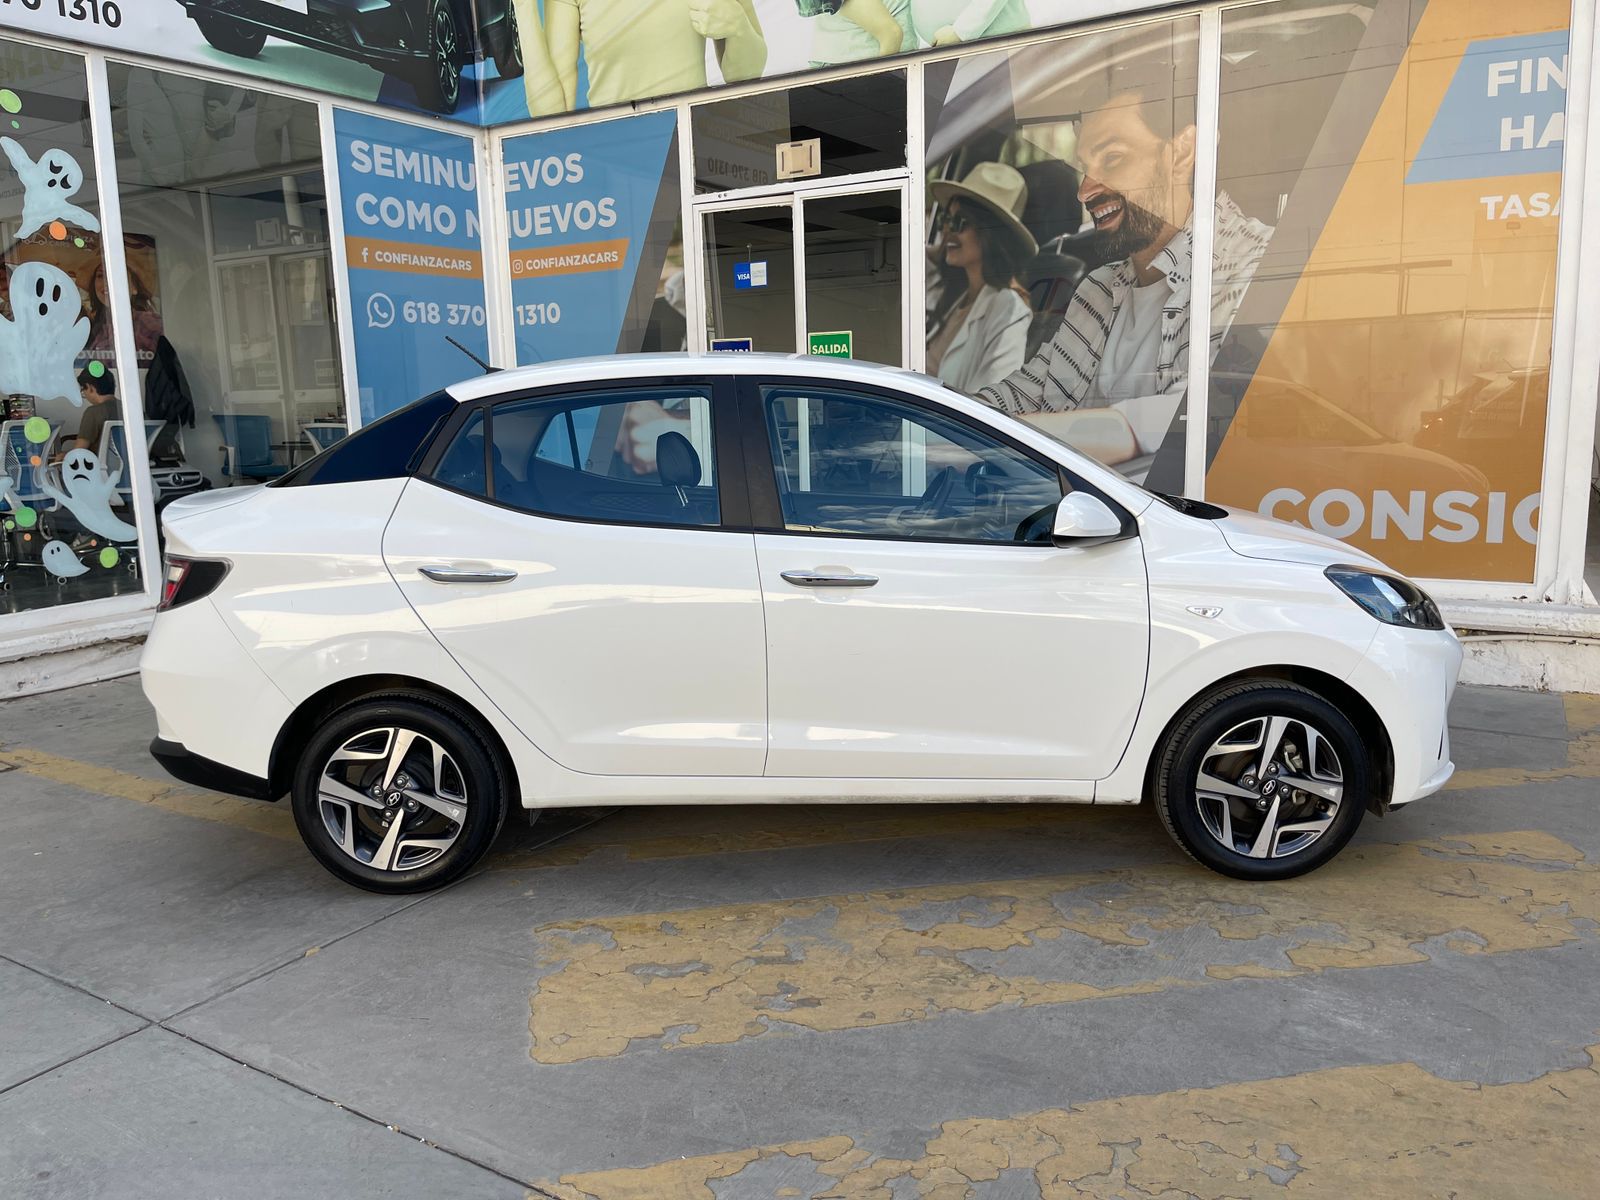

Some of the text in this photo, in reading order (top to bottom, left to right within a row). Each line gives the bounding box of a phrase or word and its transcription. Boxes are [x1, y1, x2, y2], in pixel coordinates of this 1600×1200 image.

[58, 0, 122, 28] 1310
[1487, 55, 1568, 97] FIN
[355, 192, 457, 235] COMO
[375, 251, 472, 272] CONFIANZACARS
[526, 251, 619, 271] CONFIANZACARS
[737, 273, 751, 281] VISA
[403, 301, 561, 327] 618 370 1310
[812, 343, 849, 355] SALIDA
